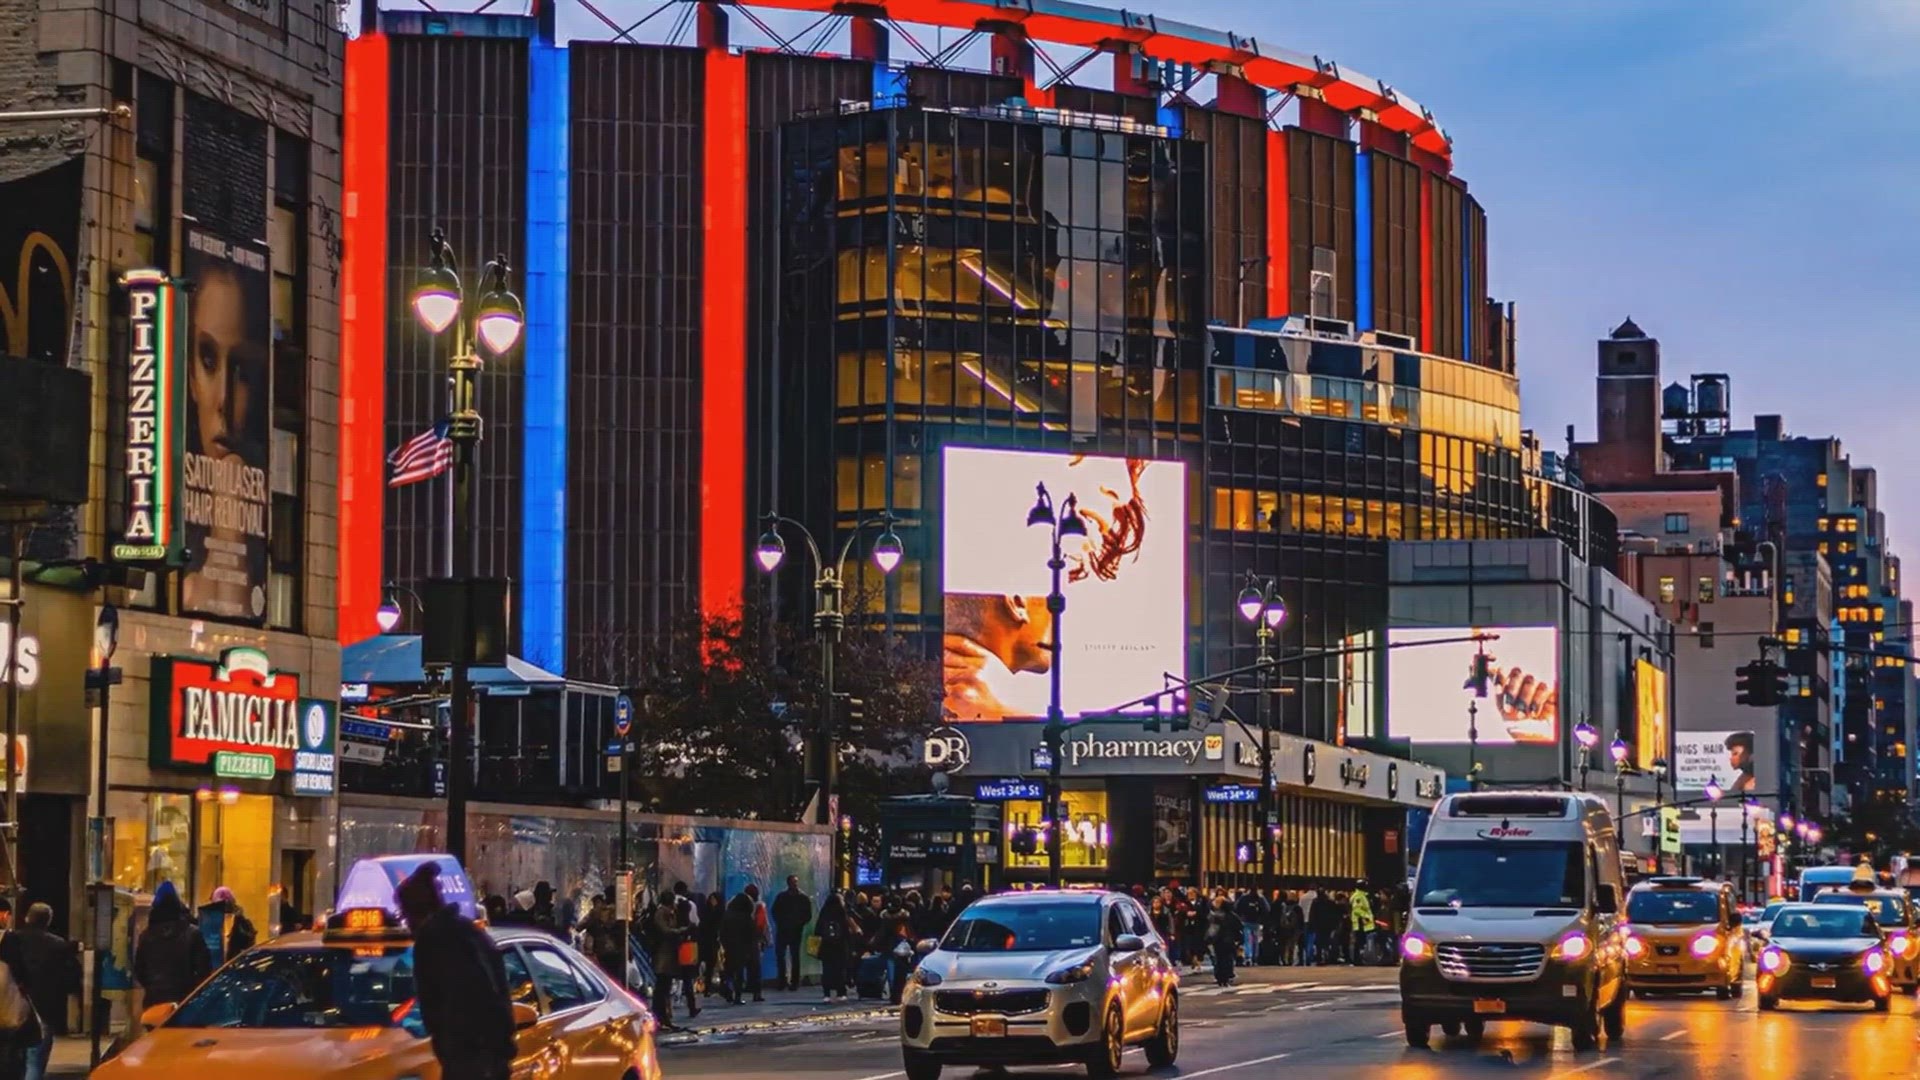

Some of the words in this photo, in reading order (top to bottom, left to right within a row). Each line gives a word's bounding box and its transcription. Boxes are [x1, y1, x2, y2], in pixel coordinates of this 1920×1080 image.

[127, 291, 156, 538] PIZZERIA
[229, 461, 266, 503] LASER
[184, 489, 213, 526] HAIR
[215, 496, 266, 538] REMOVAL
[185, 686, 300, 750] FAMIGLIA
[924, 736, 970, 765] DR
[1071, 732, 1203, 766] pharmacy
[1676, 743, 1697, 755] WIGS
[1703, 744, 1724, 754] HAIR
[219, 755, 270, 775] PIZZERIA
[980, 784, 1006, 796] West
[1008, 785, 1027, 796] 34th
[1028, 784, 1040, 796] St
[1207, 790, 1228, 800] West
[1245, 789, 1255, 799] St
[1489, 827, 1534, 838] Ryder
